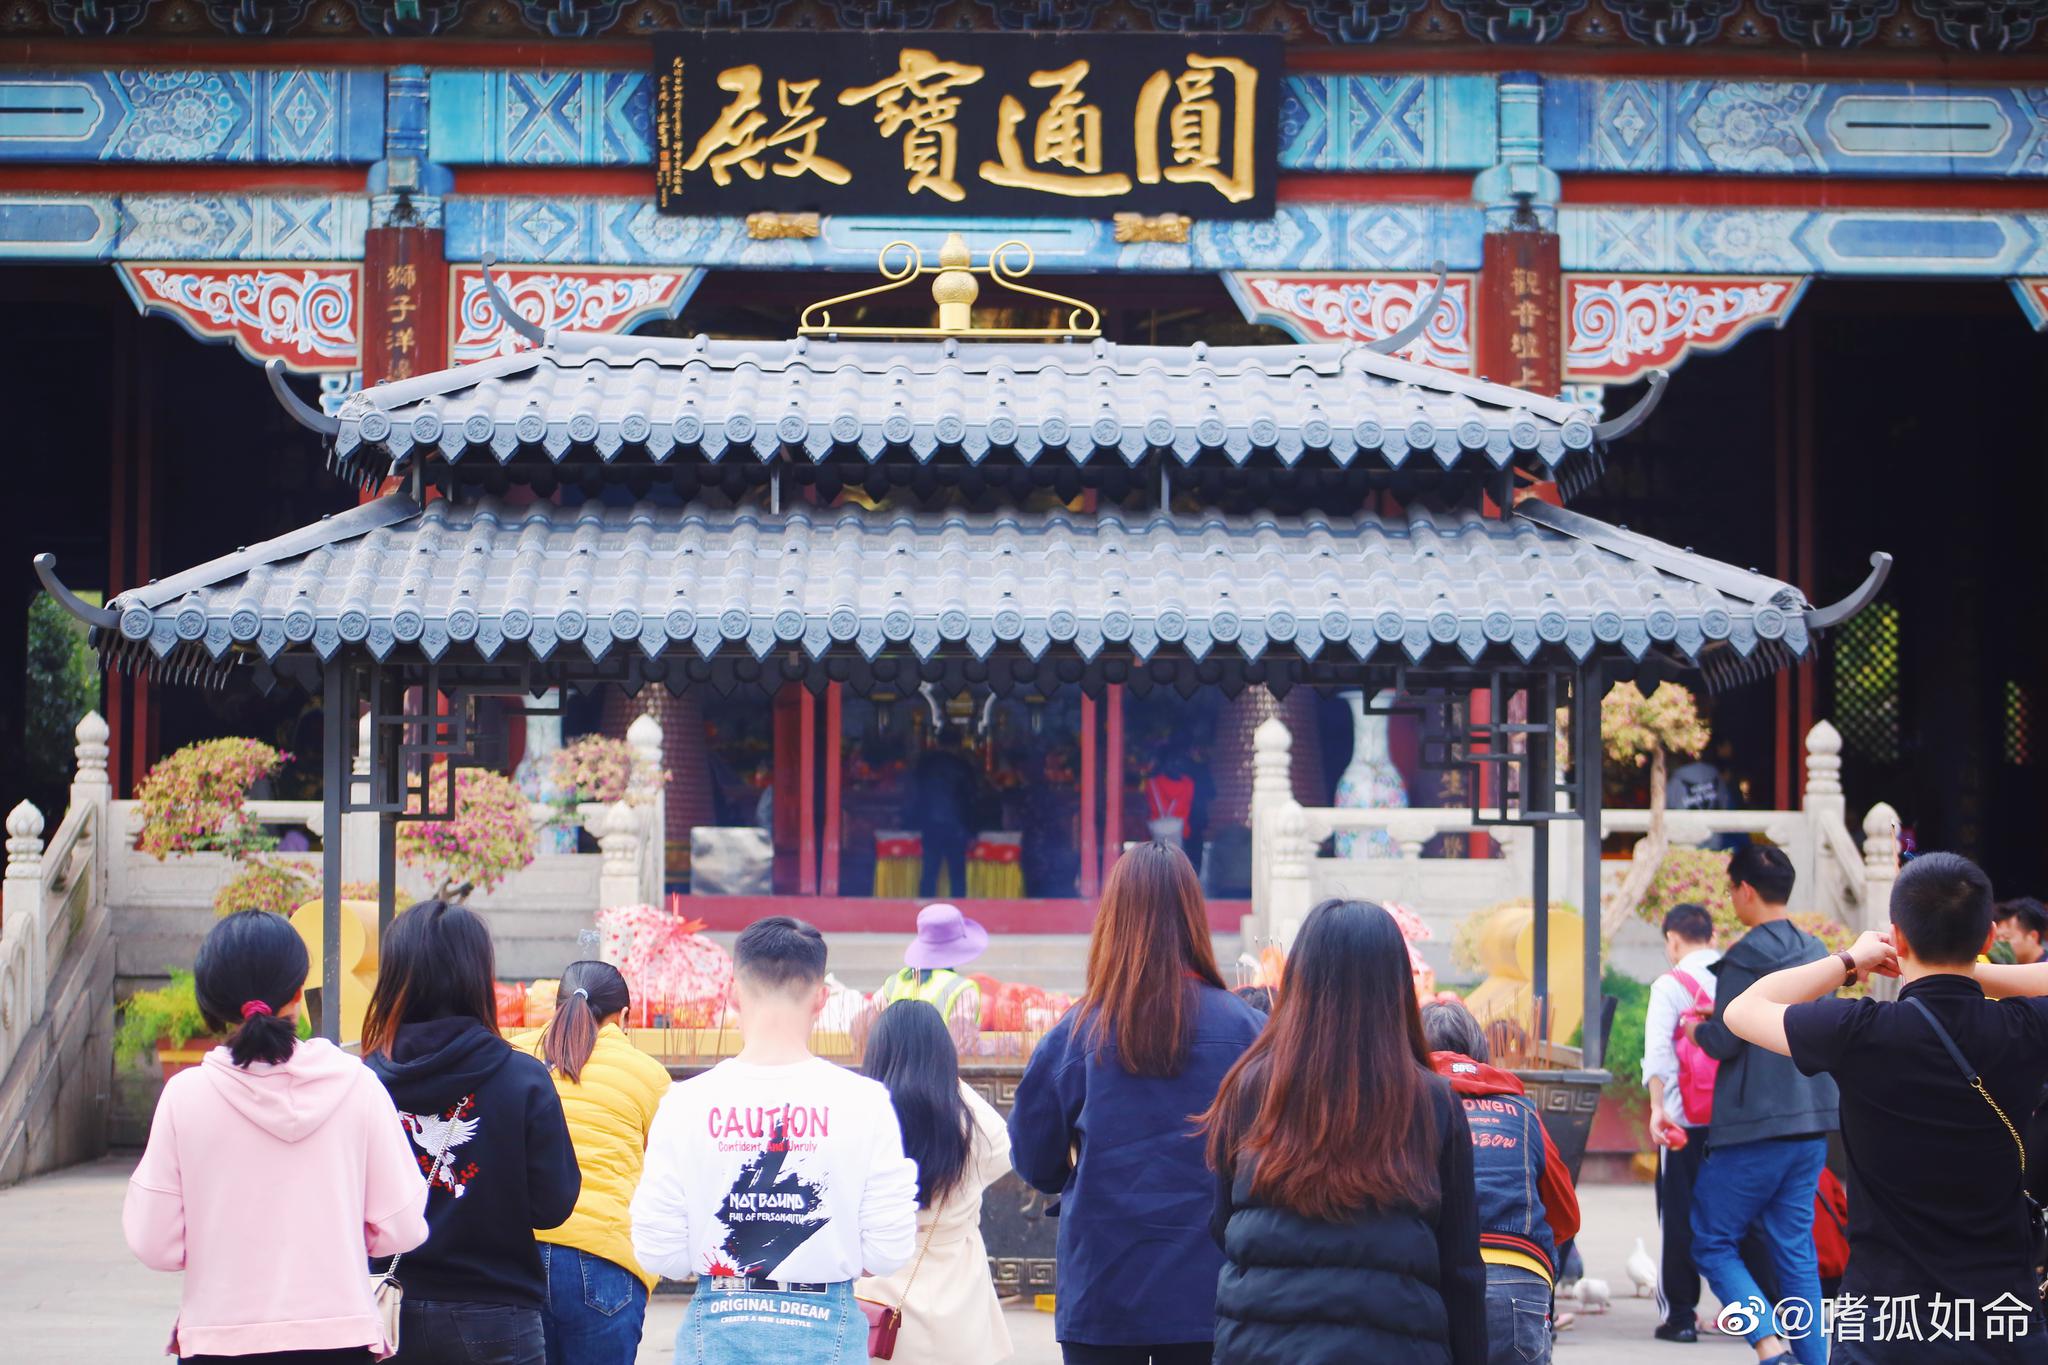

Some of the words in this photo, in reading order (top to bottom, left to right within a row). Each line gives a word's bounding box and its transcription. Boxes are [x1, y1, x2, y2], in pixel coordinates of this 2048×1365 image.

[708, 1105, 829, 1138] CAUTION
[718, 1141, 761, 1152] Confident
[788, 1141, 818, 1153] Unruly
[729, 1193, 757, 1212] NOT
[759, 1193, 805, 1211] BOUND
[710, 1298, 778, 1314] ORIGINAL
[780, 1300, 831, 1321] DREAM
